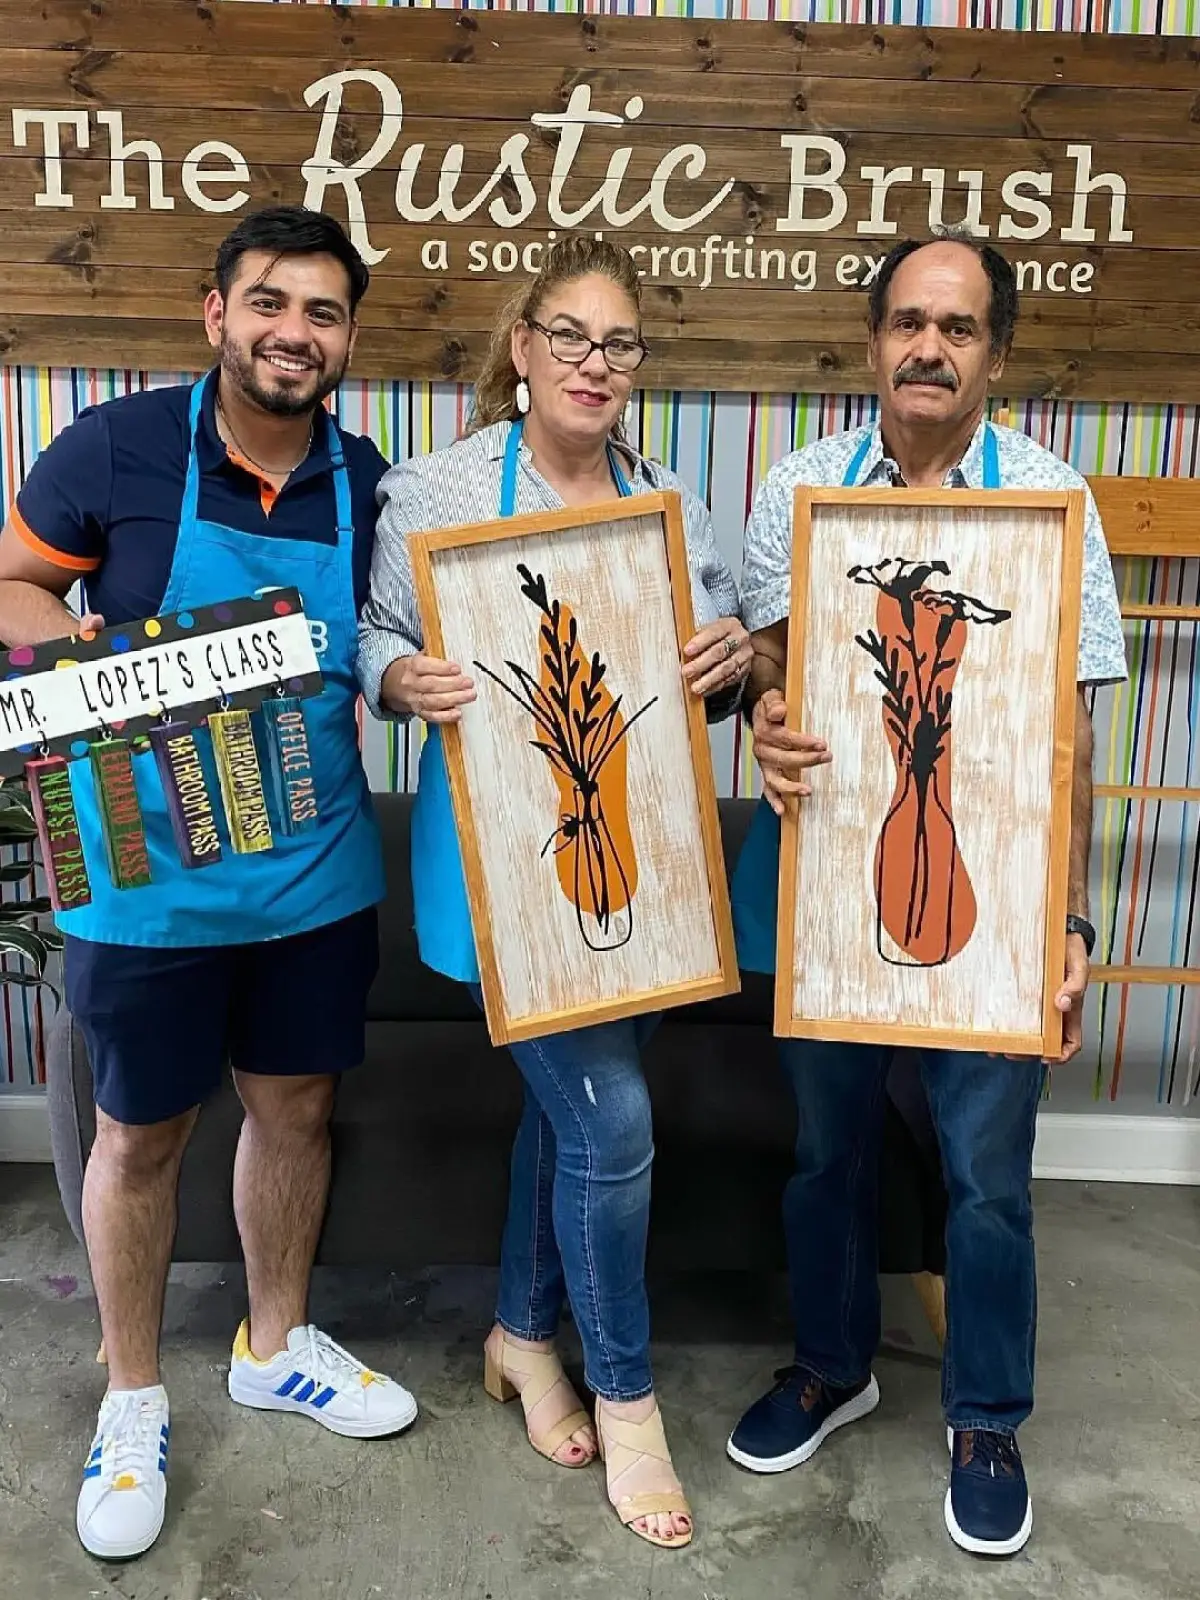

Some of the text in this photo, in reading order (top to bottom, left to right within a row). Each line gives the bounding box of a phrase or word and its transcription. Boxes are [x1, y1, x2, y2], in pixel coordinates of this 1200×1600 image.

[11, 68, 1134, 267] The Rustic Brush
[421, 239, 449, 270] a
[835, 252, 1095, 292] exnce
[0, 630, 284, 734] MR. LOPEZ'S CLASS
[101, 750, 150, 879] ERRAND PASS
[167, 734, 221, 857] BATHROOM PASS
[223, 721, 271, 840] BATHROOM PASS
[277, 711, 318, 822] OFFICE PASS
[39, 770, 90, 902] NURSE PASS
